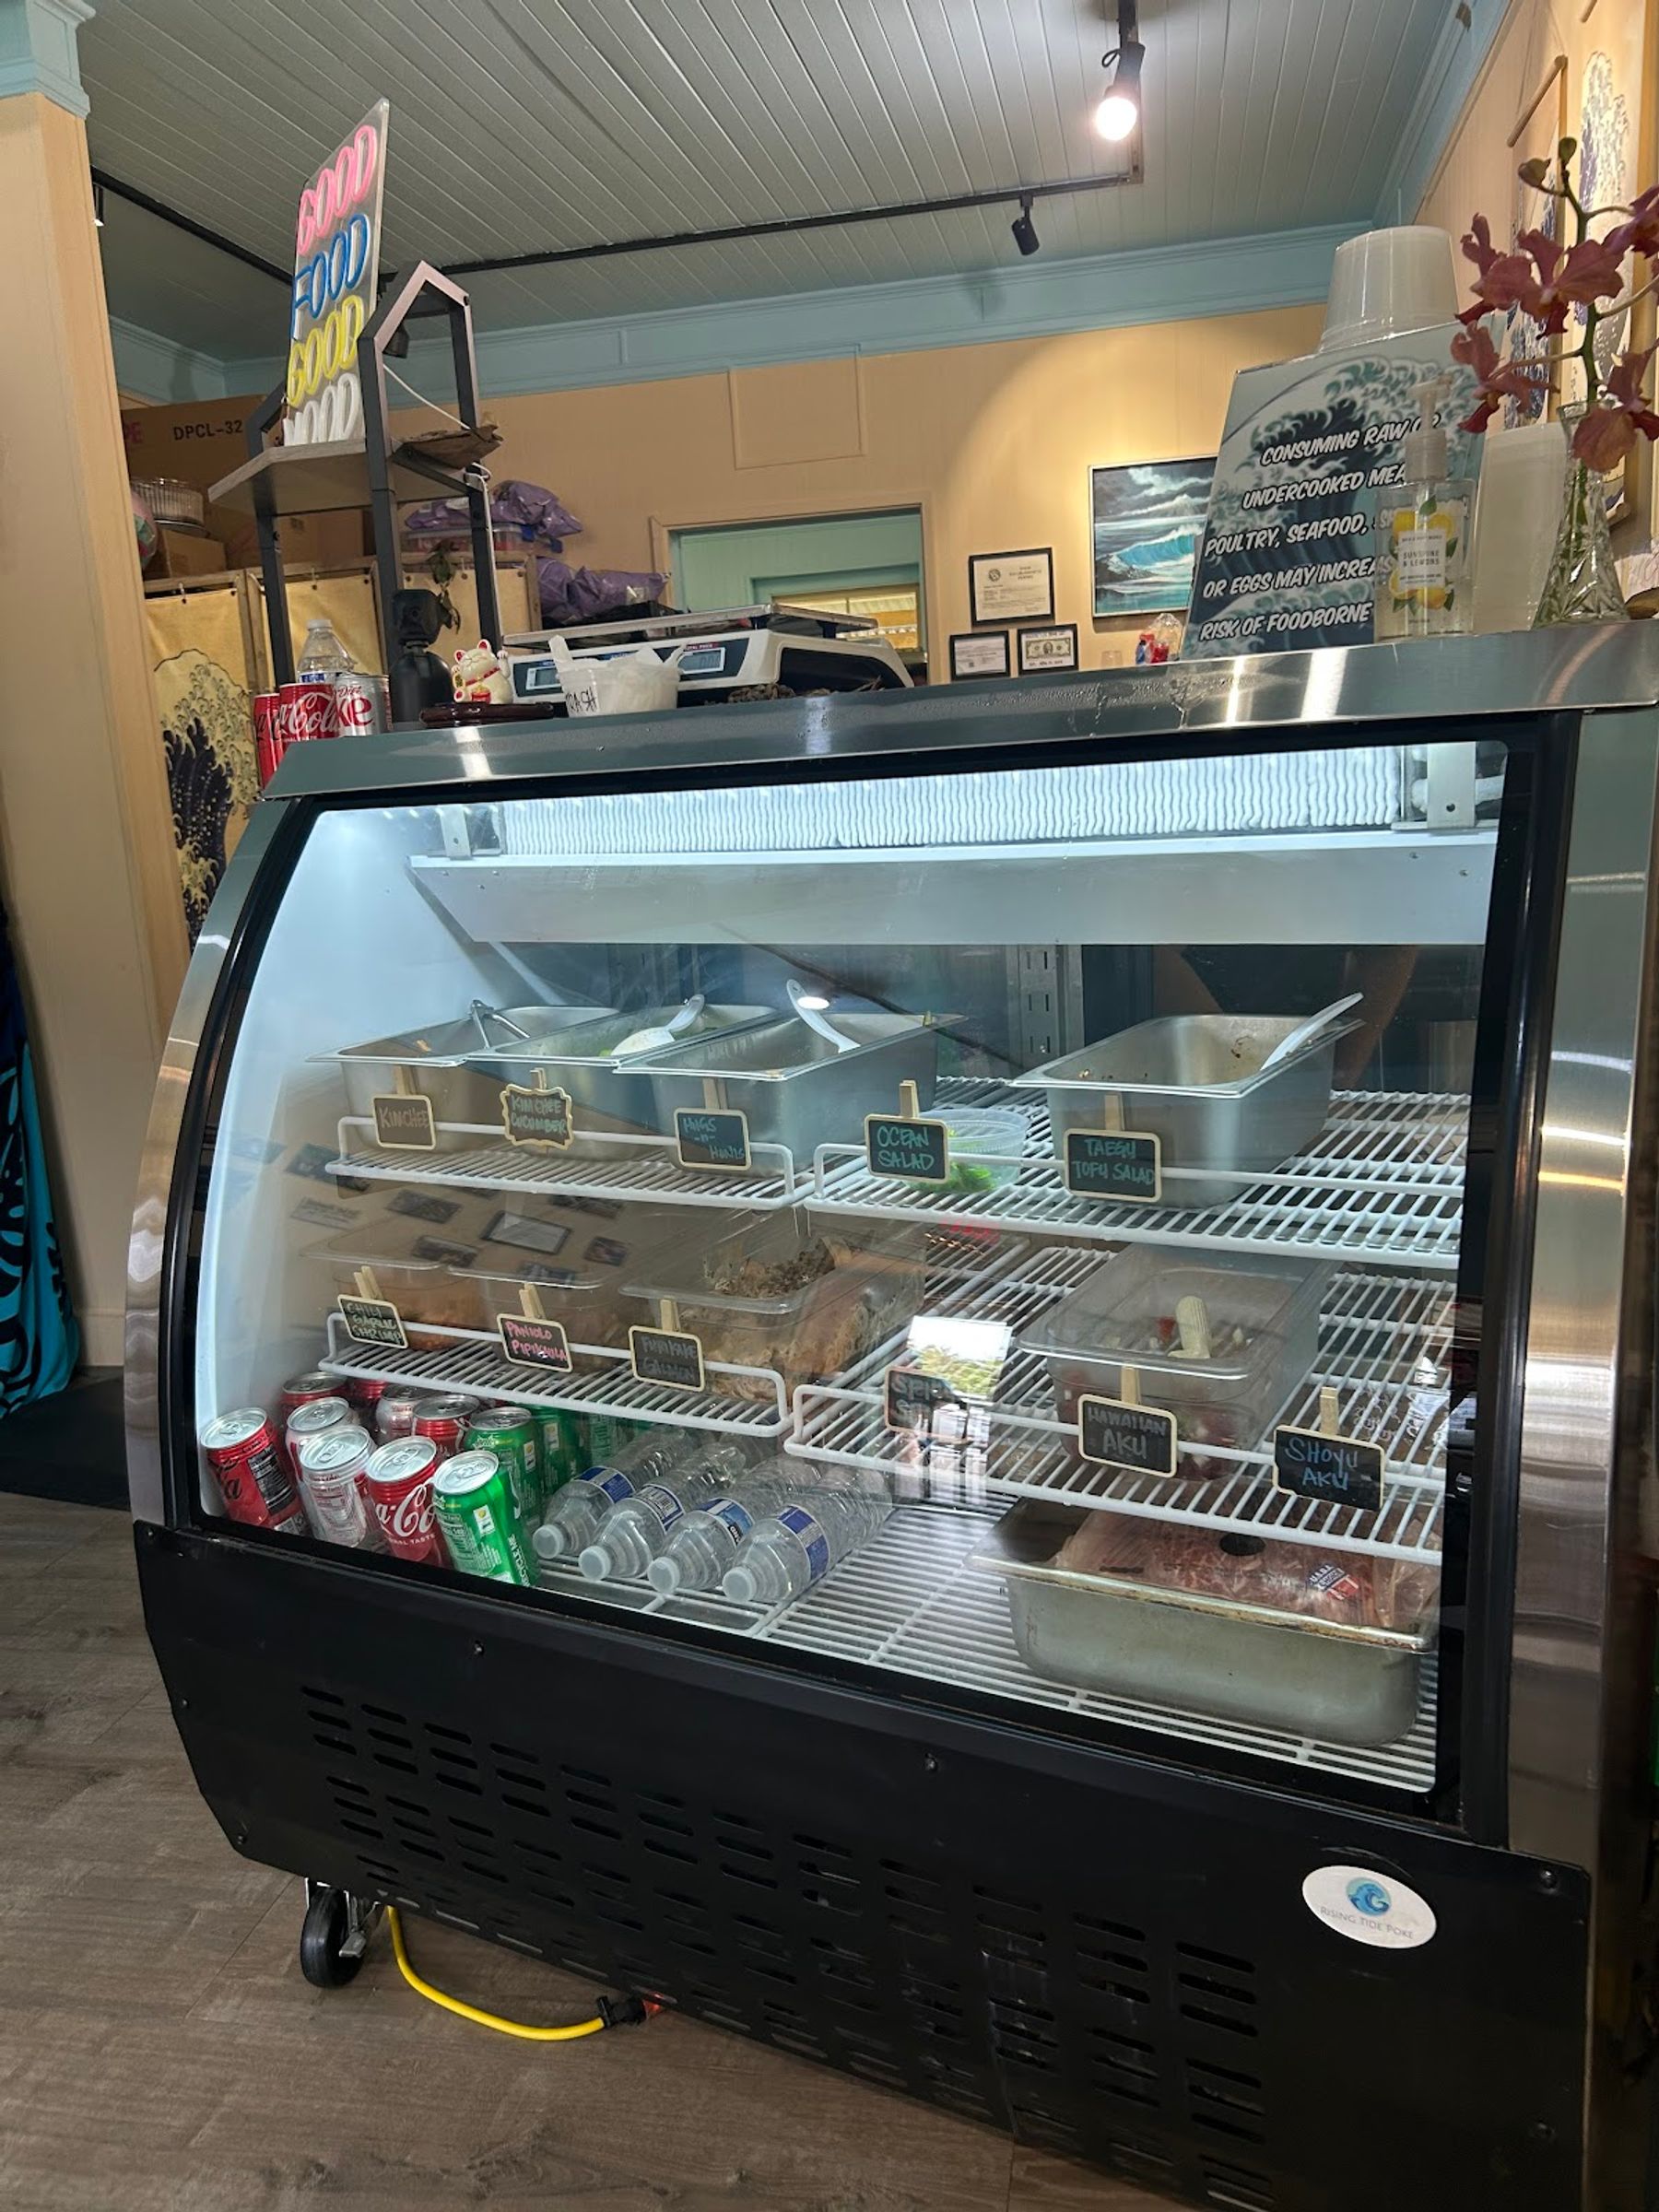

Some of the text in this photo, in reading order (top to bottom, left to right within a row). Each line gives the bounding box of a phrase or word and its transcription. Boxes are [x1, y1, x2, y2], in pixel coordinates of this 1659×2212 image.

[298, 125, 377, 256] GOOD
[289, 213, 371, 342] FOOD
[287, 295, 365, 407] GOOD
[173, 419, 243, 441] DPCL-32
[1261, 430, 1360, 466] CONSUMING
[1364, 418, 1413, 445] RAW
[1242, 464, 1406, 510] UNDERCOOKED MEA
[1204, 528, 1280, 557] POULTRY,
[1286, 512, 1368, 544] SEAFOOD,
[1203, 579, 1224, 599] OR
[1230, 571, 1273, 594] EGGS
[1274, 564, 1318, 590] MAY
[1200, 602, 1372, 641] RISK OF FOODBORNE
[877, 1125, 930, 1147] OCEAN
[877, 1150, 935, 1171] SALAD
[1071, 1160, 1155, 1185] TOFU SALAD
[347, 1302, 382, 1318] CHILI
[1087, 1407, 1168, 1436] HAWAIIAN
[1102, 1430, 1147, 1461] AKU
[1285, 1437, 1358, 1477] SHOYU
[1301, 1468, 1349, 1490] AKU
[1321, 1906, 1414, 1939] RISING TIDE POKE
